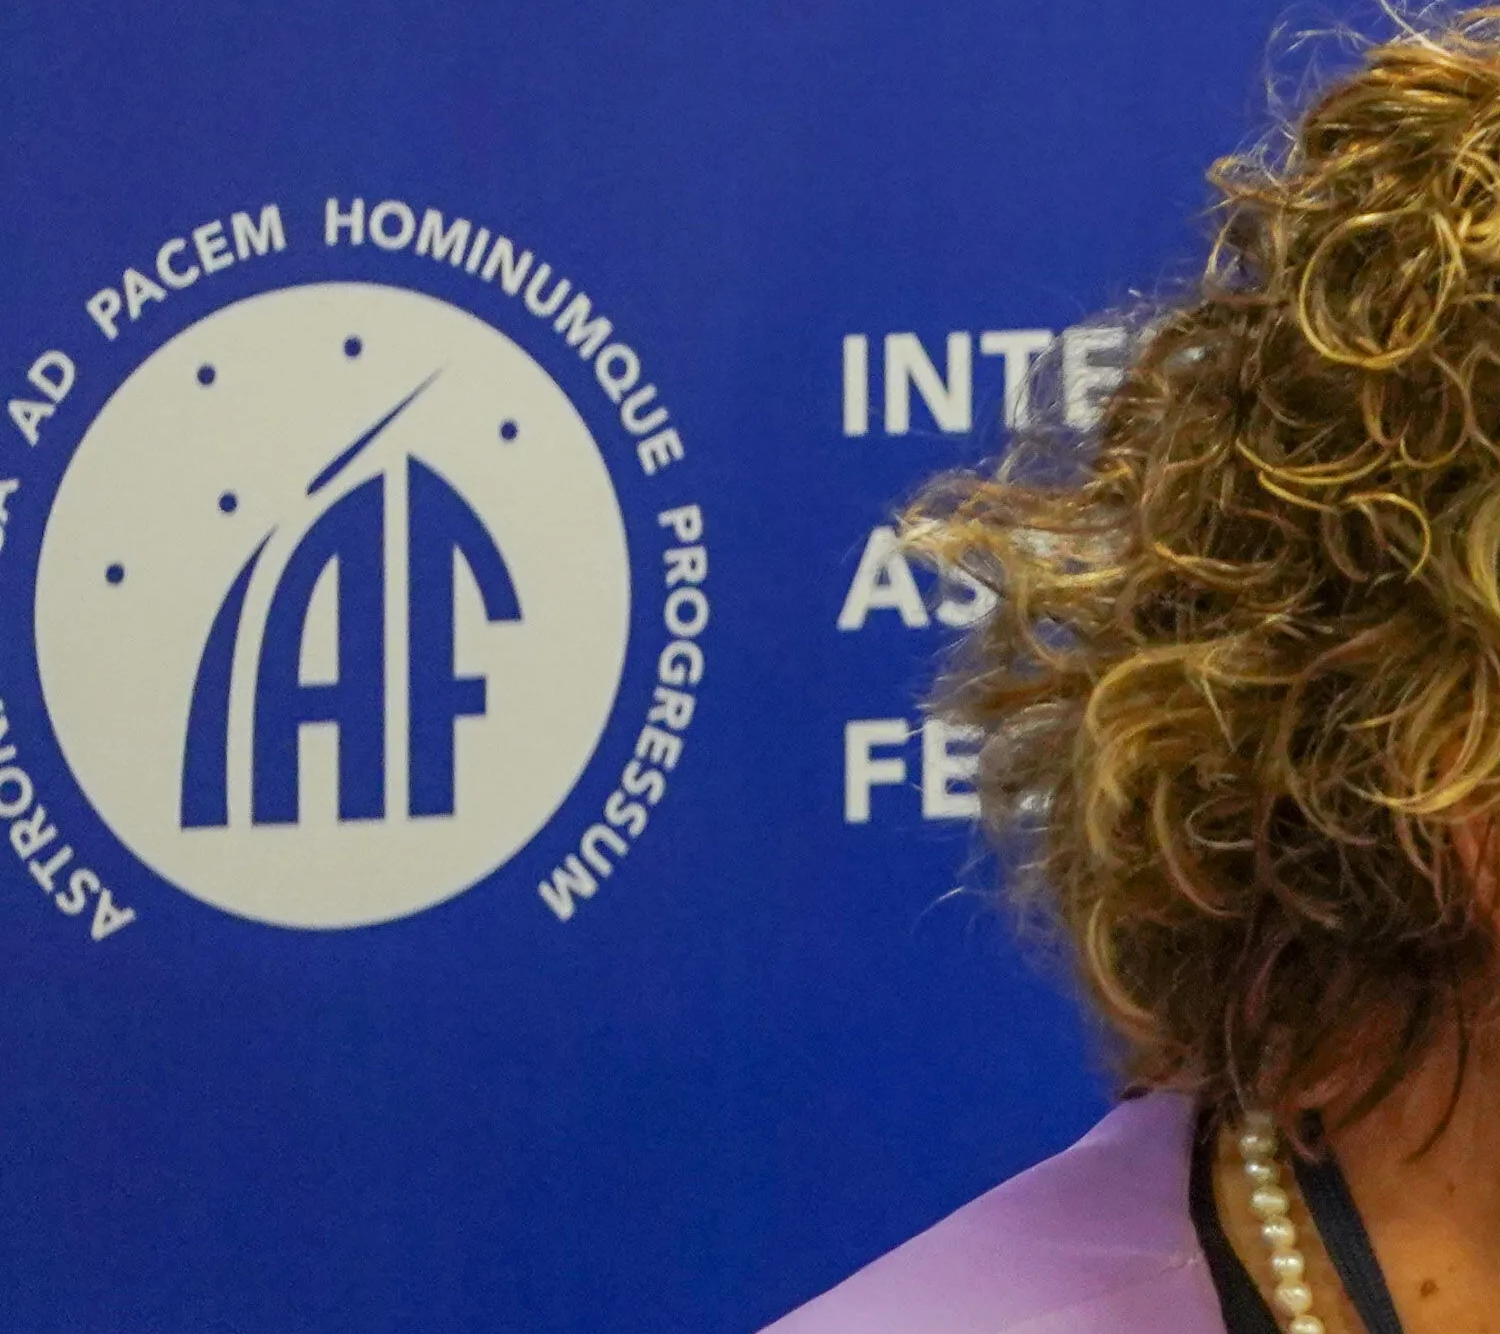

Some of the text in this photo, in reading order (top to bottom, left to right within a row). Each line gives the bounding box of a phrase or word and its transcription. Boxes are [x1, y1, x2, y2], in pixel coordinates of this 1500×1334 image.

[7, 349, 76, 447] AD
[85, 203, 287, 341] PACEM
[324, 197, 685, 475] HOMINUMQUE
[538, 504, 710, 920] PROGRESSUM
